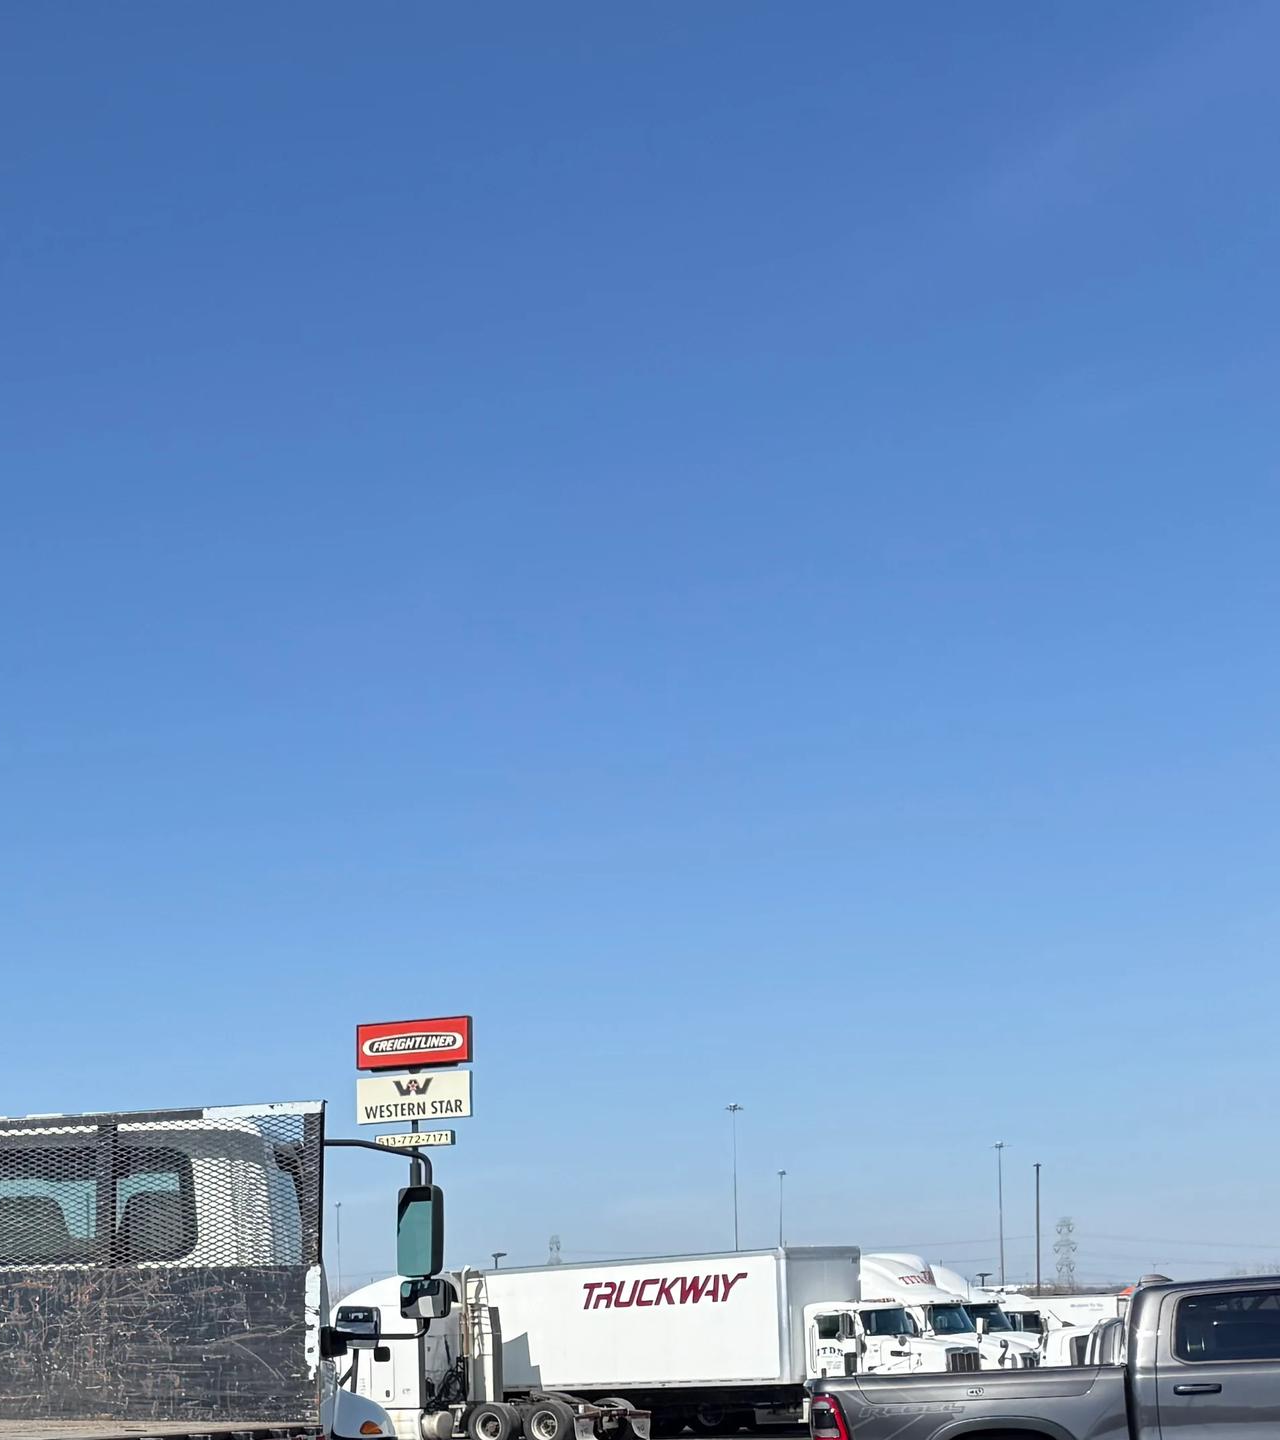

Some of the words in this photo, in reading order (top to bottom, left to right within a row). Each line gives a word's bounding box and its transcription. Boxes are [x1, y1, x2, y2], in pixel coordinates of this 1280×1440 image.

[372, 1034, 454, 1053] FREIGHTLINER
[365, 1101, 426, 1120] WESTERN
[431, 1099, 463, 1115] STAR
[378, 1133, 449, 1147] 513-772-7171
[583, 1272, 748, 1310] TRUCKWAY
